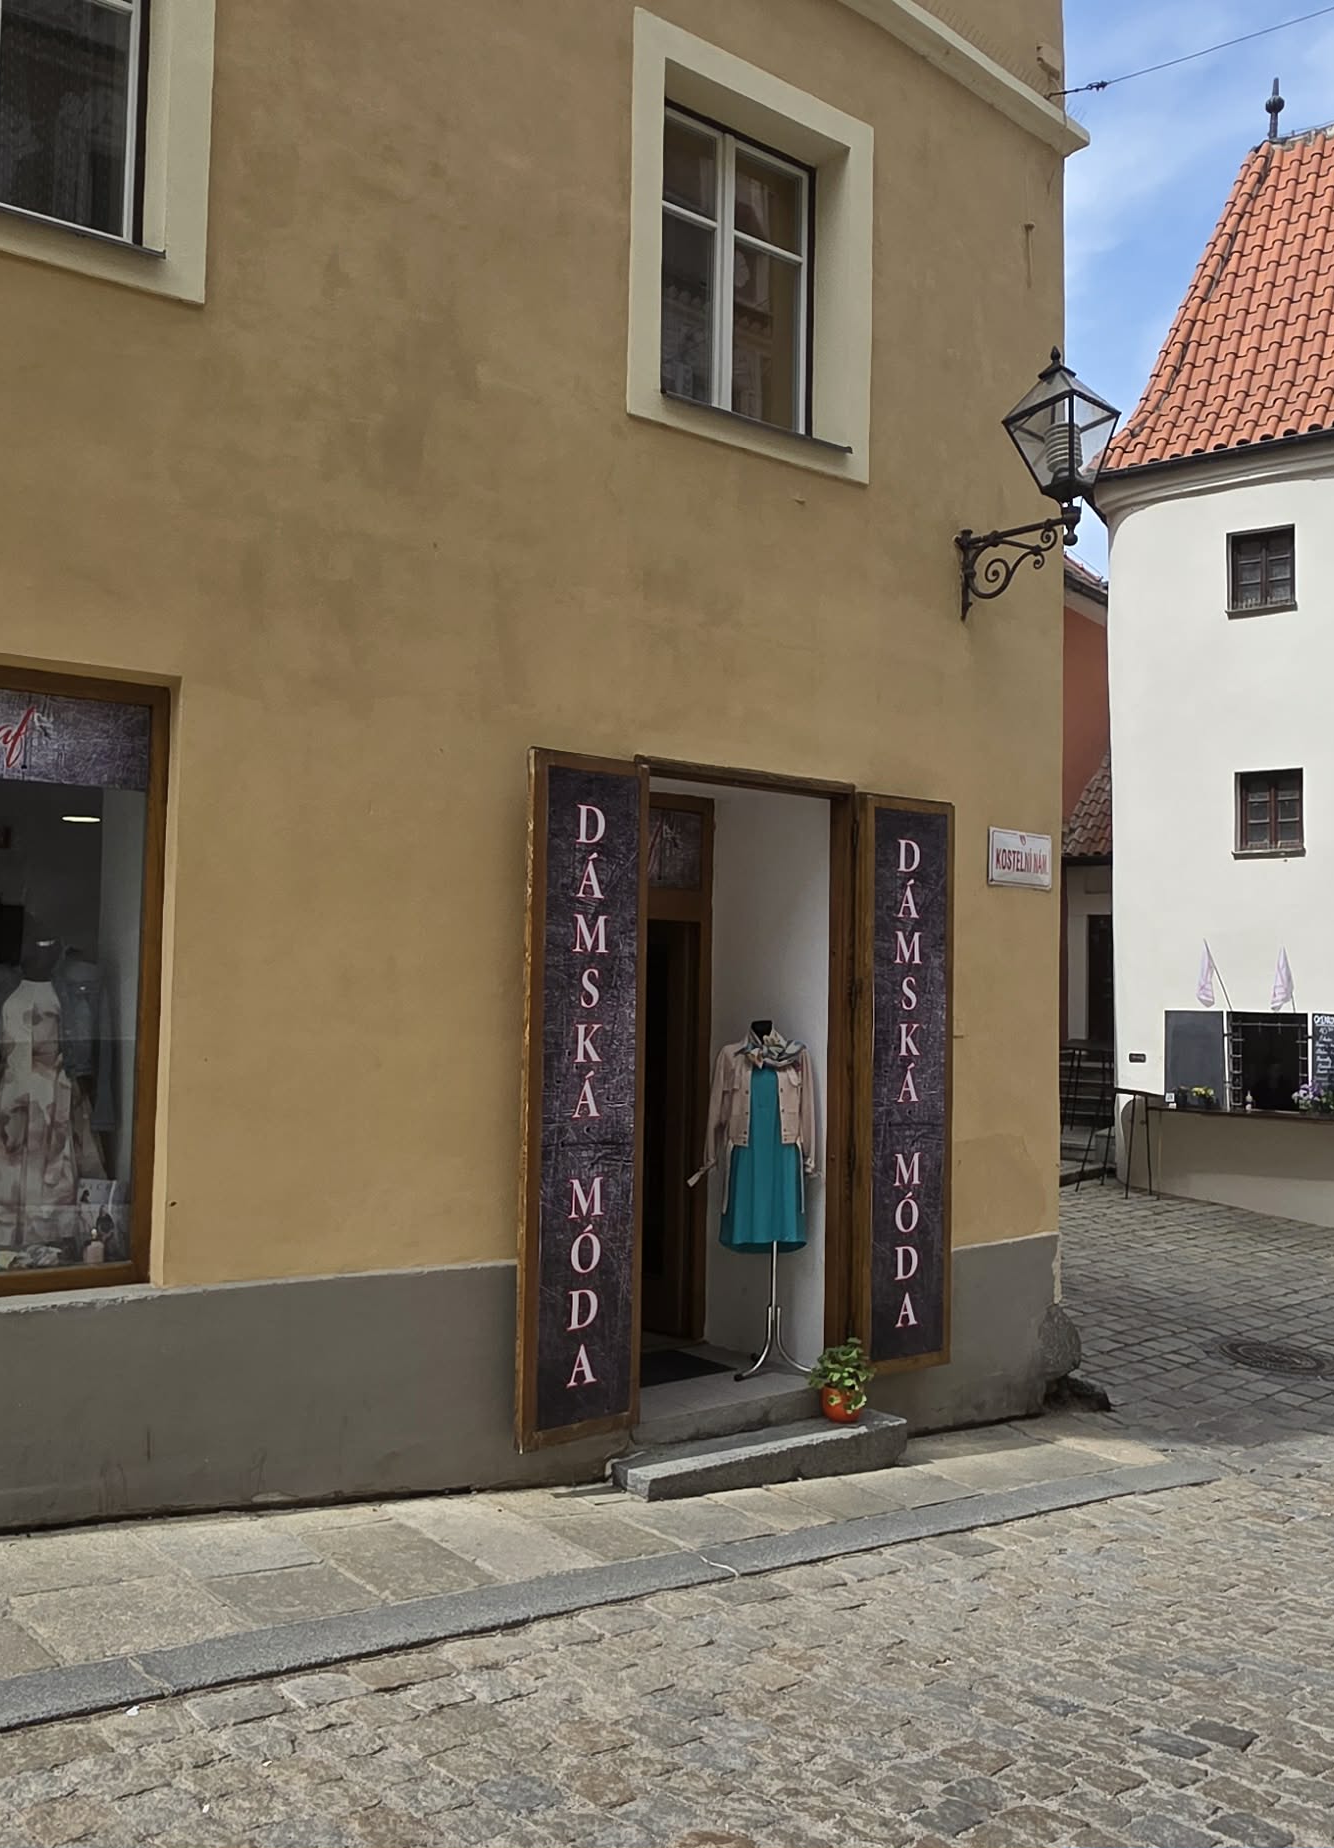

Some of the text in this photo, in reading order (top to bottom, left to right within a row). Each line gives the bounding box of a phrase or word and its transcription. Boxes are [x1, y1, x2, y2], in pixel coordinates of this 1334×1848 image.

[567, 803, 609, 1388] DÁMSKÁ MÓDA
[893, 838, 923, 1328] DÁMSKÁ MÓDA
[995, 847, 1033, 873] KOSTELNÍ
